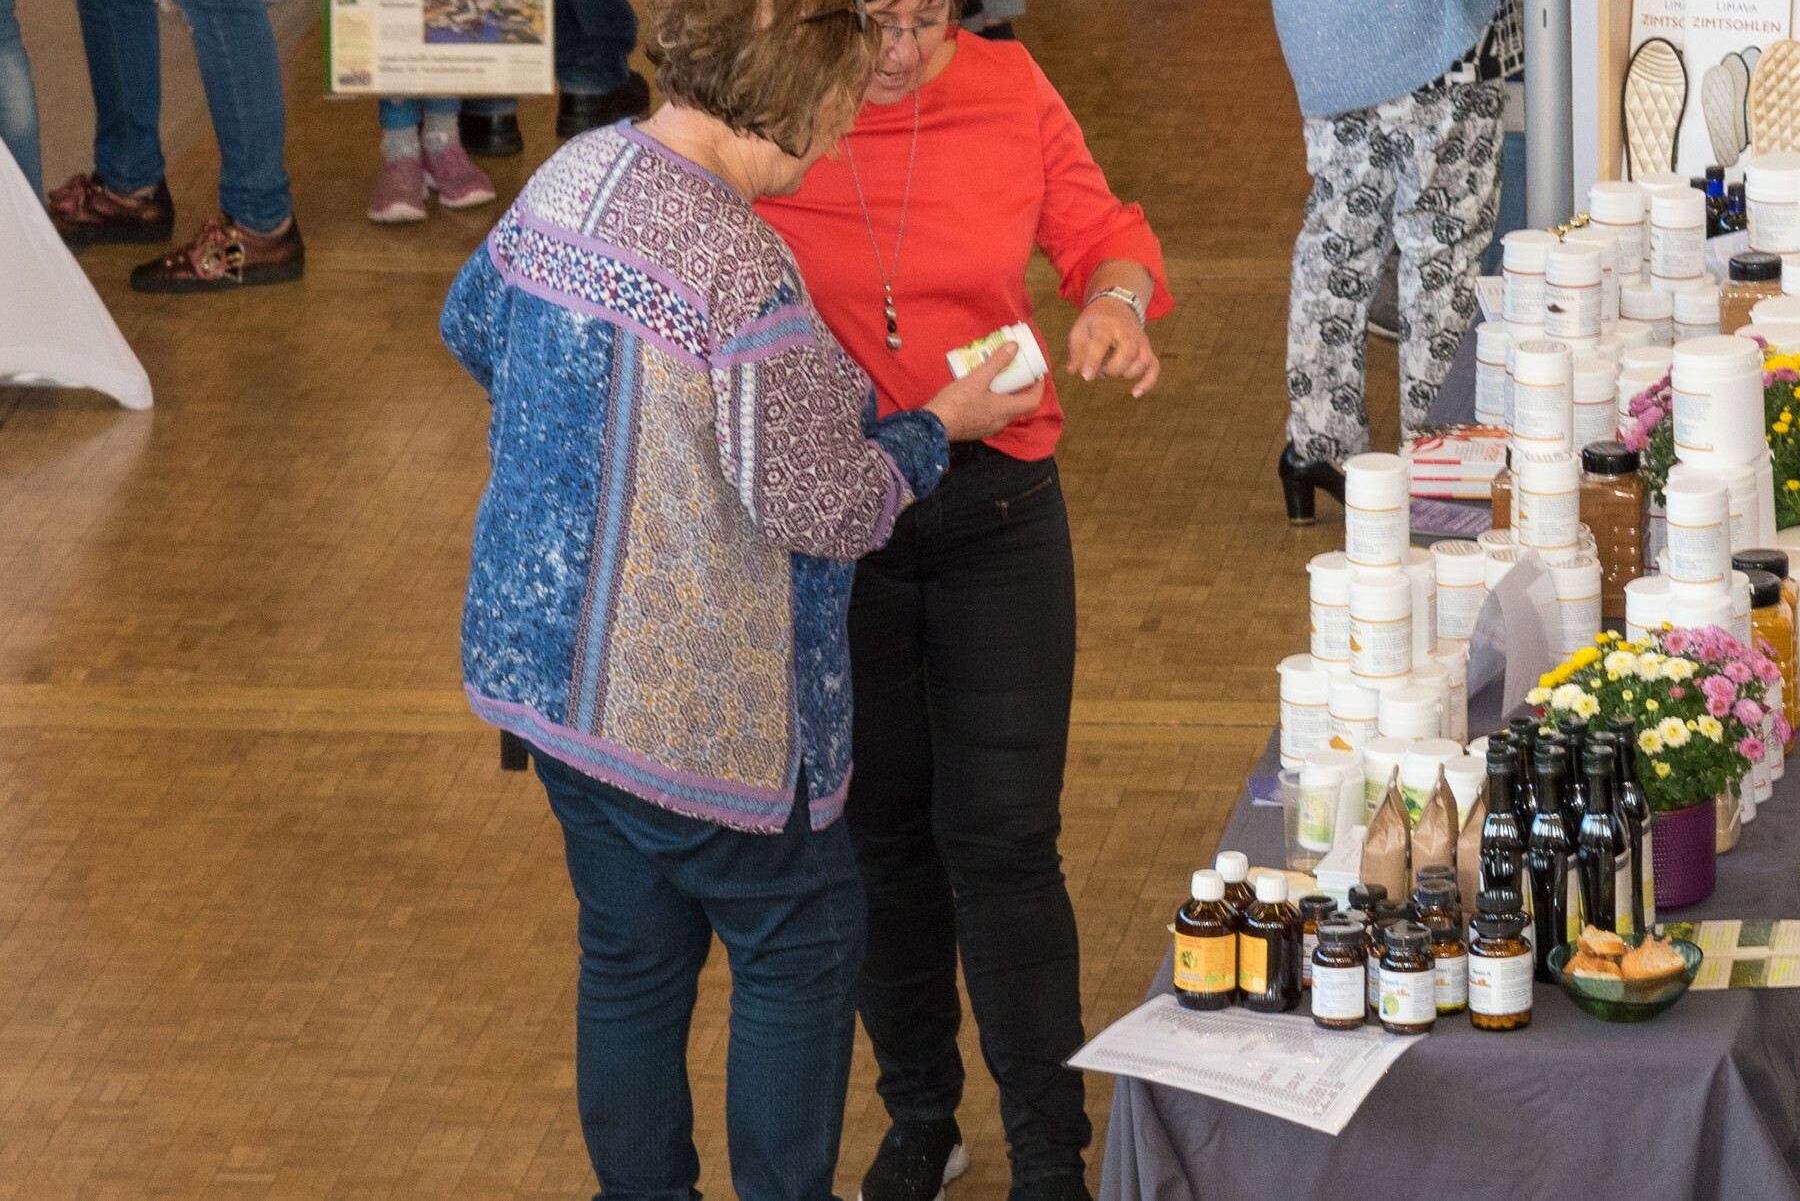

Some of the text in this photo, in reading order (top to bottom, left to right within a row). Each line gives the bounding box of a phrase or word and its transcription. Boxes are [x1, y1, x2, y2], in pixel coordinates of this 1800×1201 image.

[1664, 0, 1685, 11] LIM
[1716, 1, 1758, 13] LIMAVA
[1693, 16, 1782, 33] ZIMTSOHLEN
